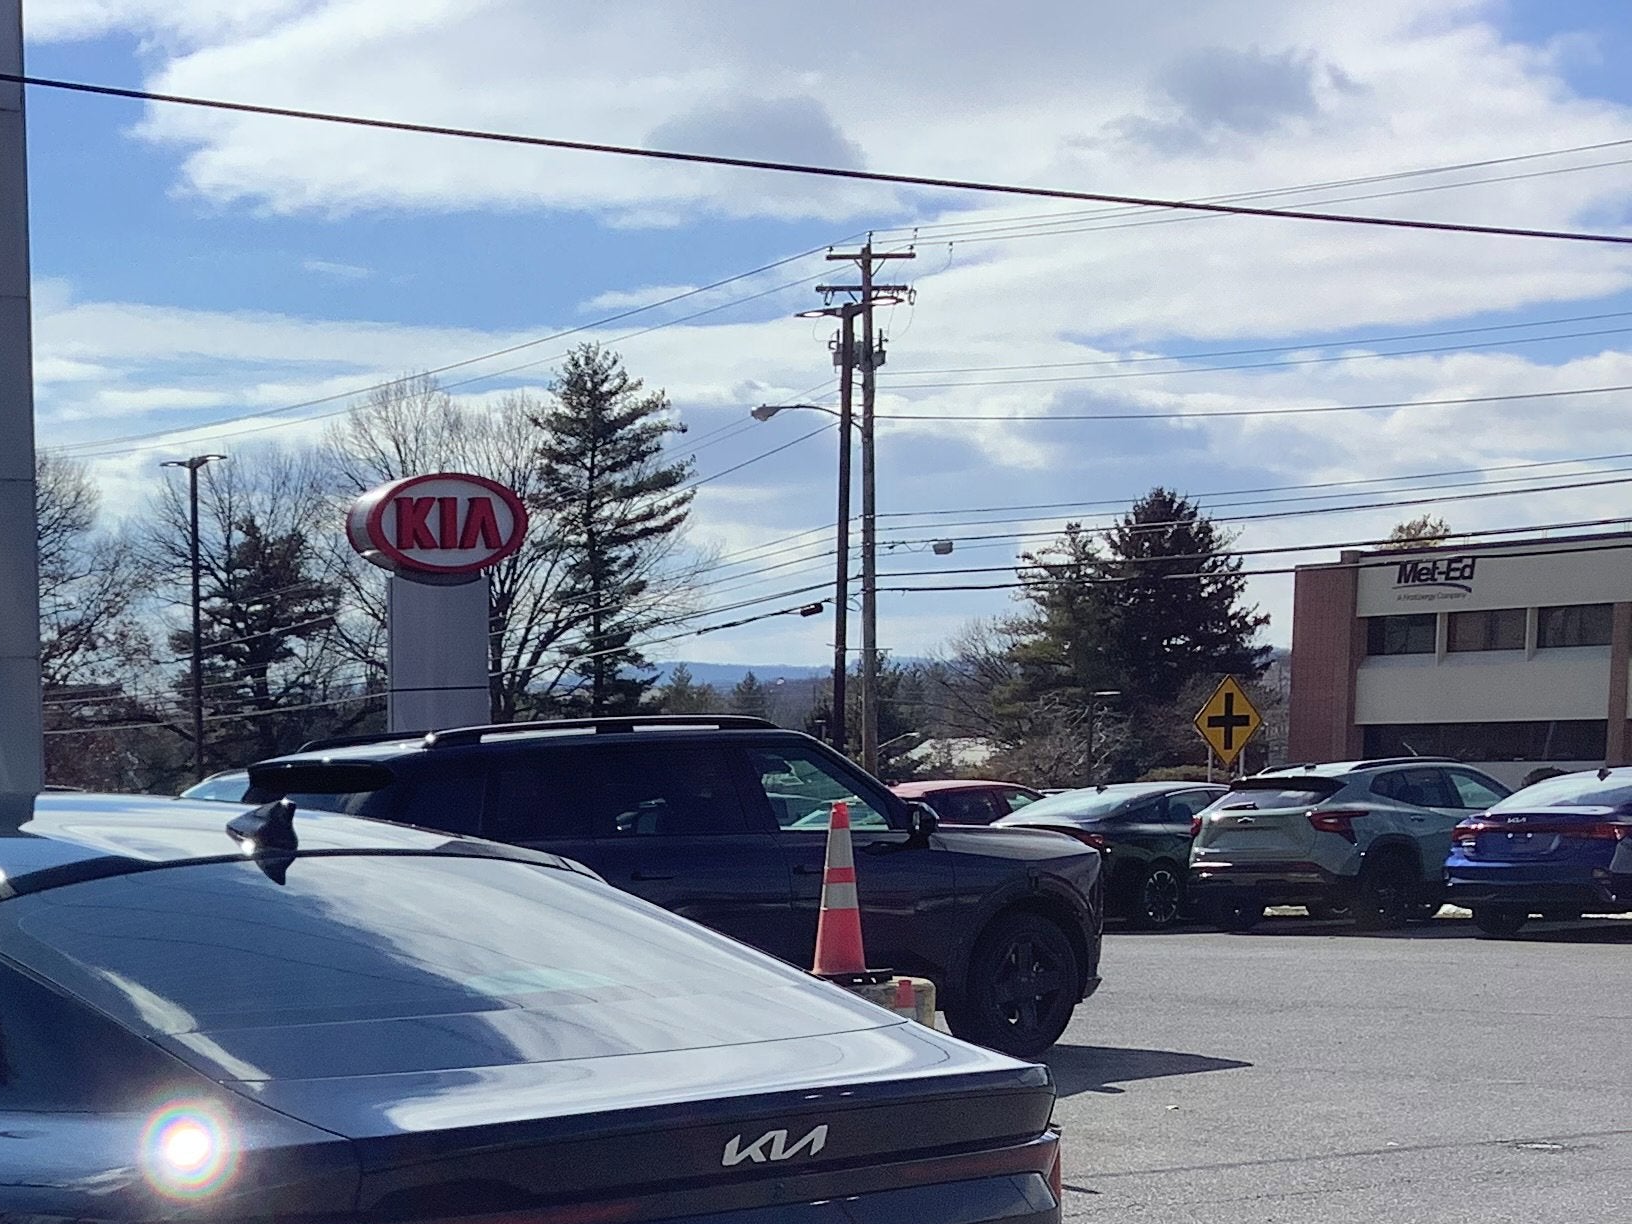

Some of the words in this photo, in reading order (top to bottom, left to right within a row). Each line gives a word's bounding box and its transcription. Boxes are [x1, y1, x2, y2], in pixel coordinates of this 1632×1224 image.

[393, 496, 503, 550] KIA
[1397, 557, 1476, 584] Met-Ed
[721, 1124, 828, 1167] KIA
